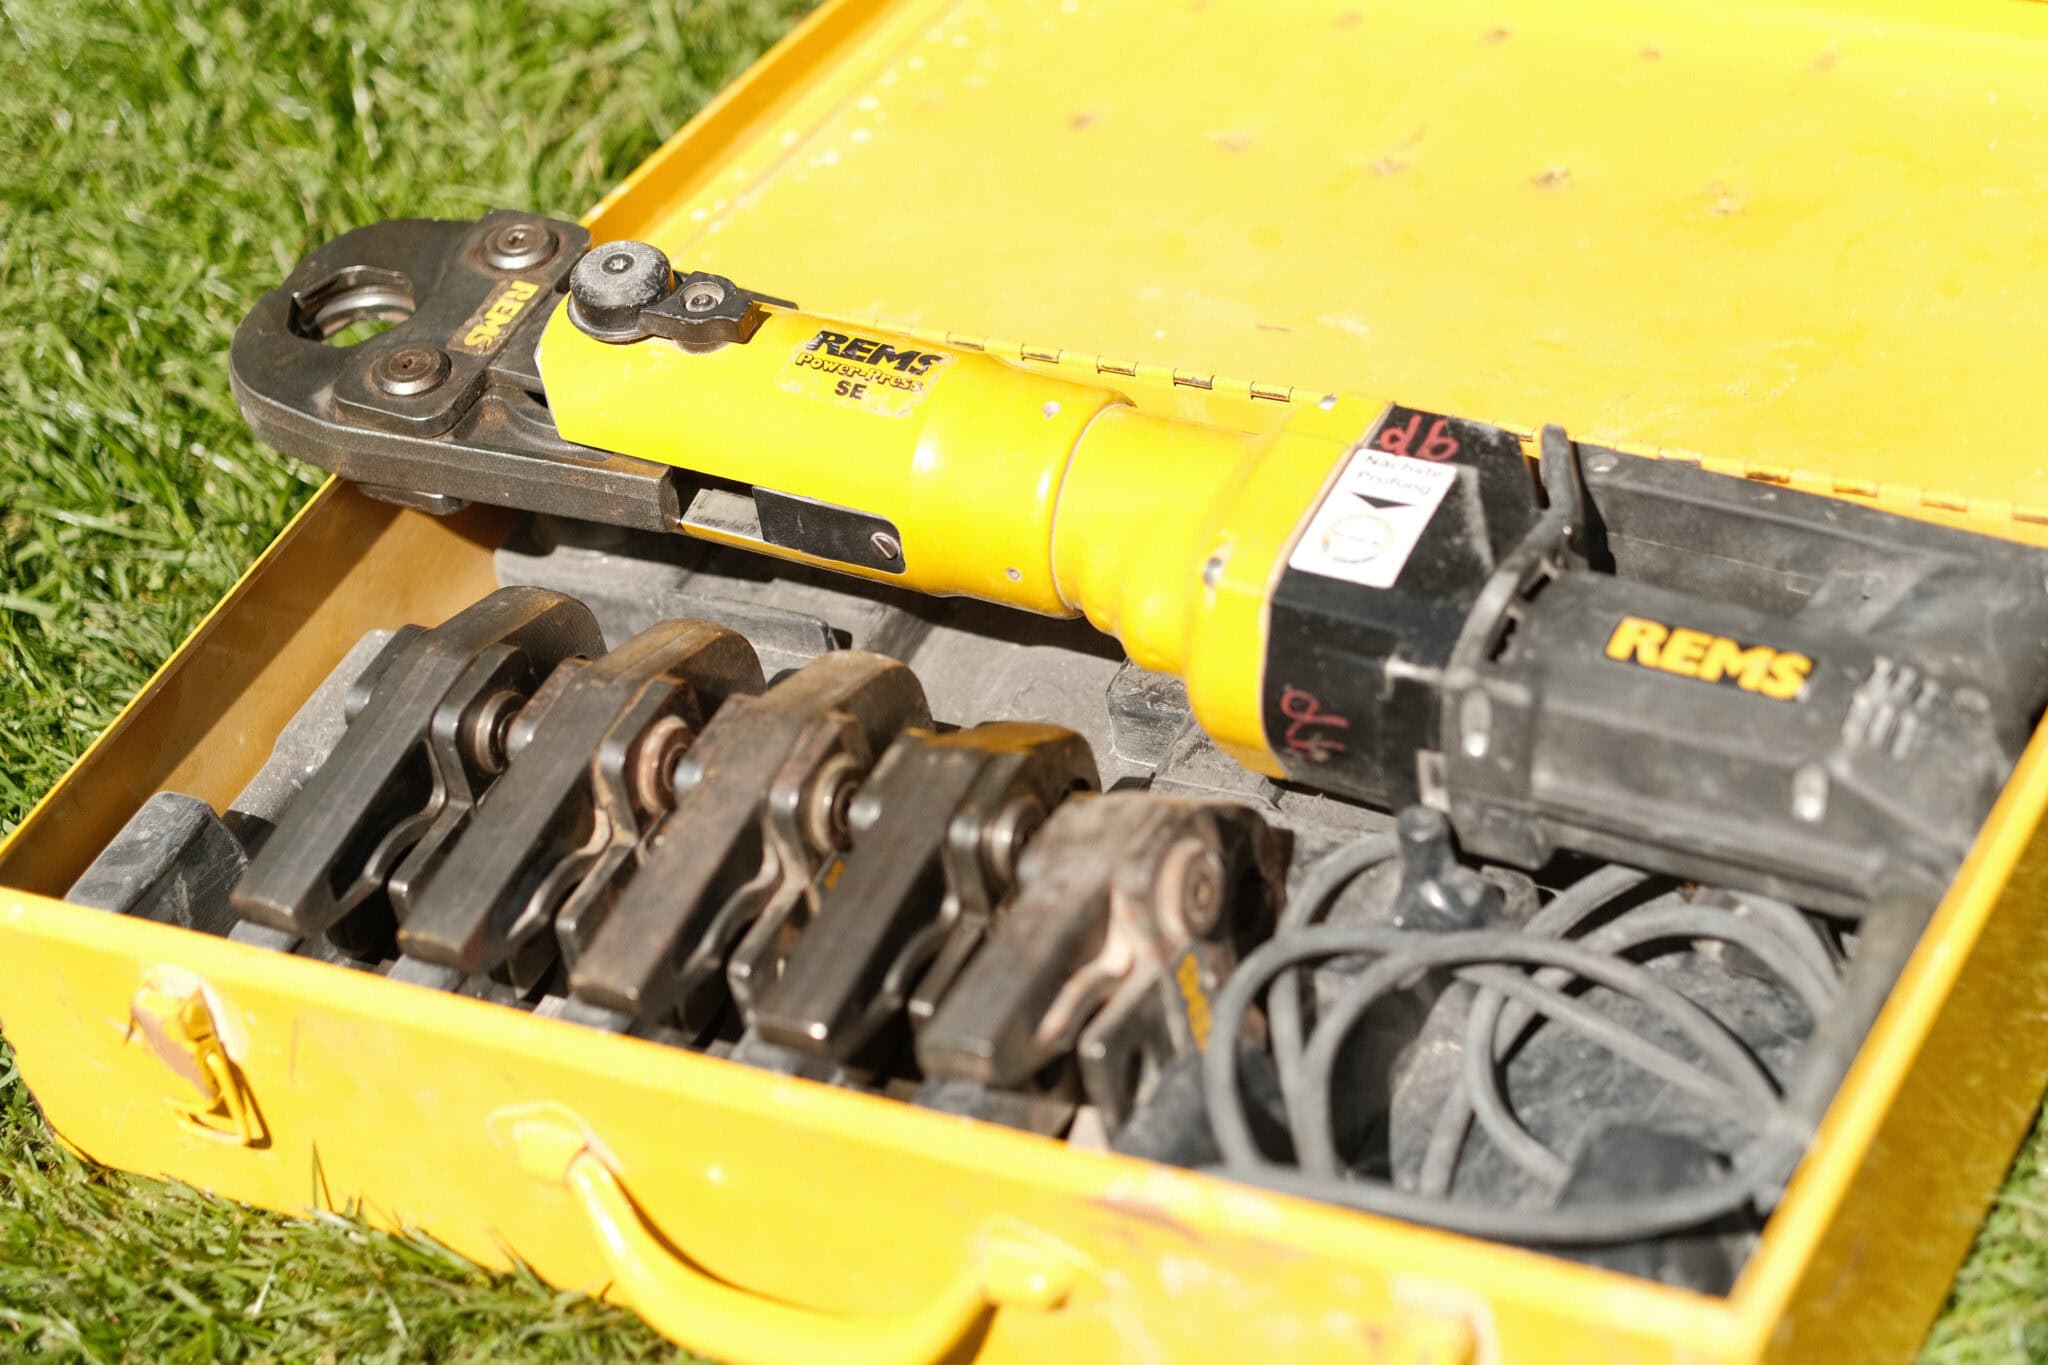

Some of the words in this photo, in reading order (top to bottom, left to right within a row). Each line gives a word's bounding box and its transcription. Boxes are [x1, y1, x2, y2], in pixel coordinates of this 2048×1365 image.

[463, 279, 540, 349] REMS
[796, 351, 924, 393] Power-Press
[806, 330, 943, 376] REMS
[834, 380, 867, 400] SE
[1605, 615, 1813, 700] REMS
